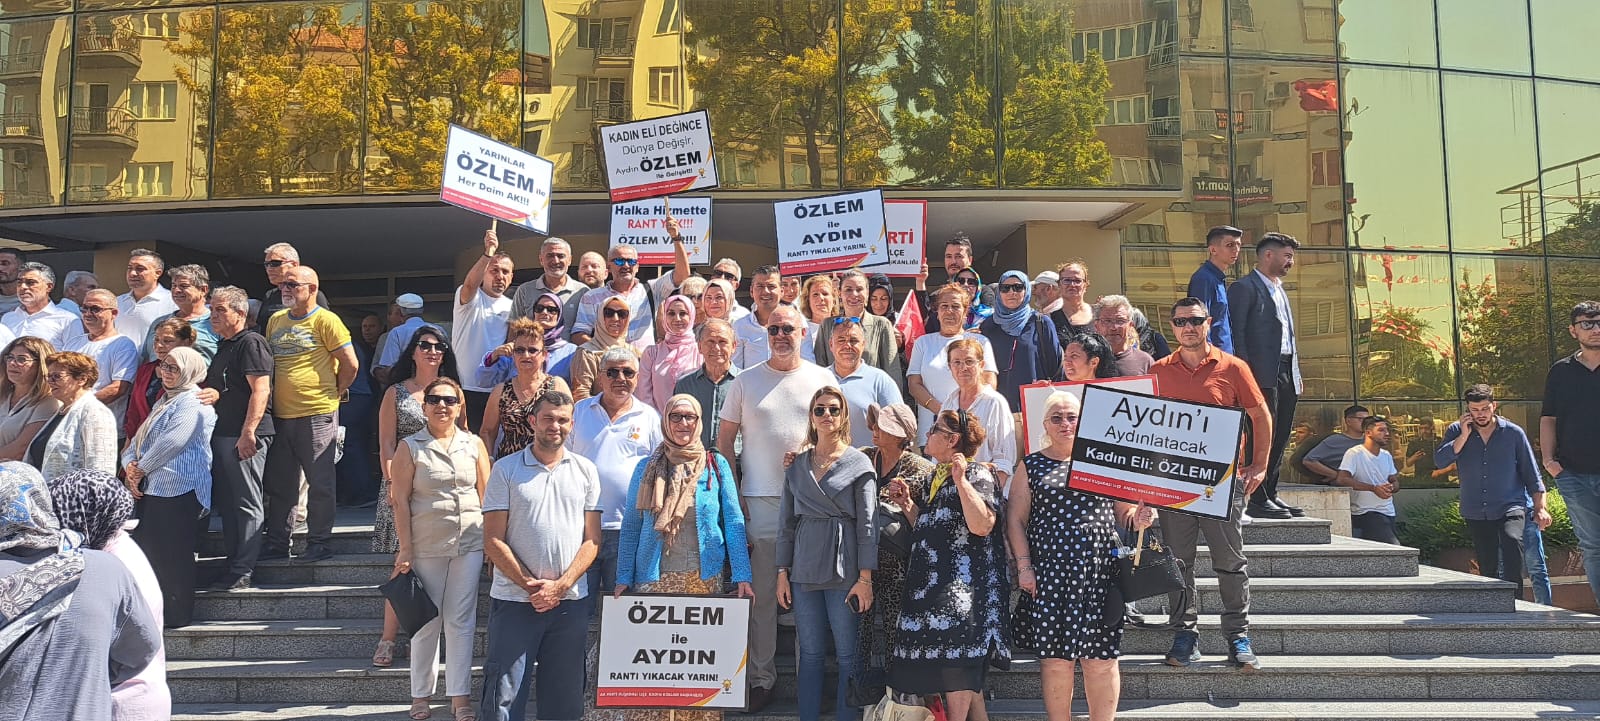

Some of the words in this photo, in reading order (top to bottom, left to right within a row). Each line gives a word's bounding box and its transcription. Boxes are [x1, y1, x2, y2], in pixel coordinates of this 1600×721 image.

[609, 130, 639, 144] KADIN
[641, 124, 657, 138] ELİ
[659, 119, 702, 136] DEĞİNCE
[623, 143, 654, 155] Dünya
[479, 147, 525, 169] YARINLAR
[615, 167, 639, 175] Aydın
[640, 151, 702, 172] ÖZLEM
[457, 150, 535, 193] ÖZLEM
[458, 175, 476, 187] Her
[506, 192, 530, 206] AK!!!
[615, 205, 649, 215] Halka
[653, 205, 707, 215] Himette
[794, 199, 864, 219] ÖZLEM
[628, 219, 657, 228] RANT
[660, 219, 693, 228] YK!!!
[618, 233, 658, 245] ÖZLEM
[801, 228, 862, 246] AYDIN
[888, 228, 914, 244] RTİ
[787, 250, 808, 258] RANTI
[810, 246, 842, 256] YIKACAK
[889, 249, 905, 257] LÇE
[1104, 425, 1208, 455] Aydınlatacak
[1085, 446, 1127, 466] Kadın
[1130, 455, 1154, 470] Eli:
[1158, 458, 1218, 481] ÖZLEM!
[628, 601, 724, 626] ÖZLEM
[671, 633, 688, 644] ile
[631, 649, 716, 665] AYDIN
[610, 672, 639, 681] RANTI
[642, 673, 685, 681] YIKACAK
[687, 673, 719, 682] YARIN!
